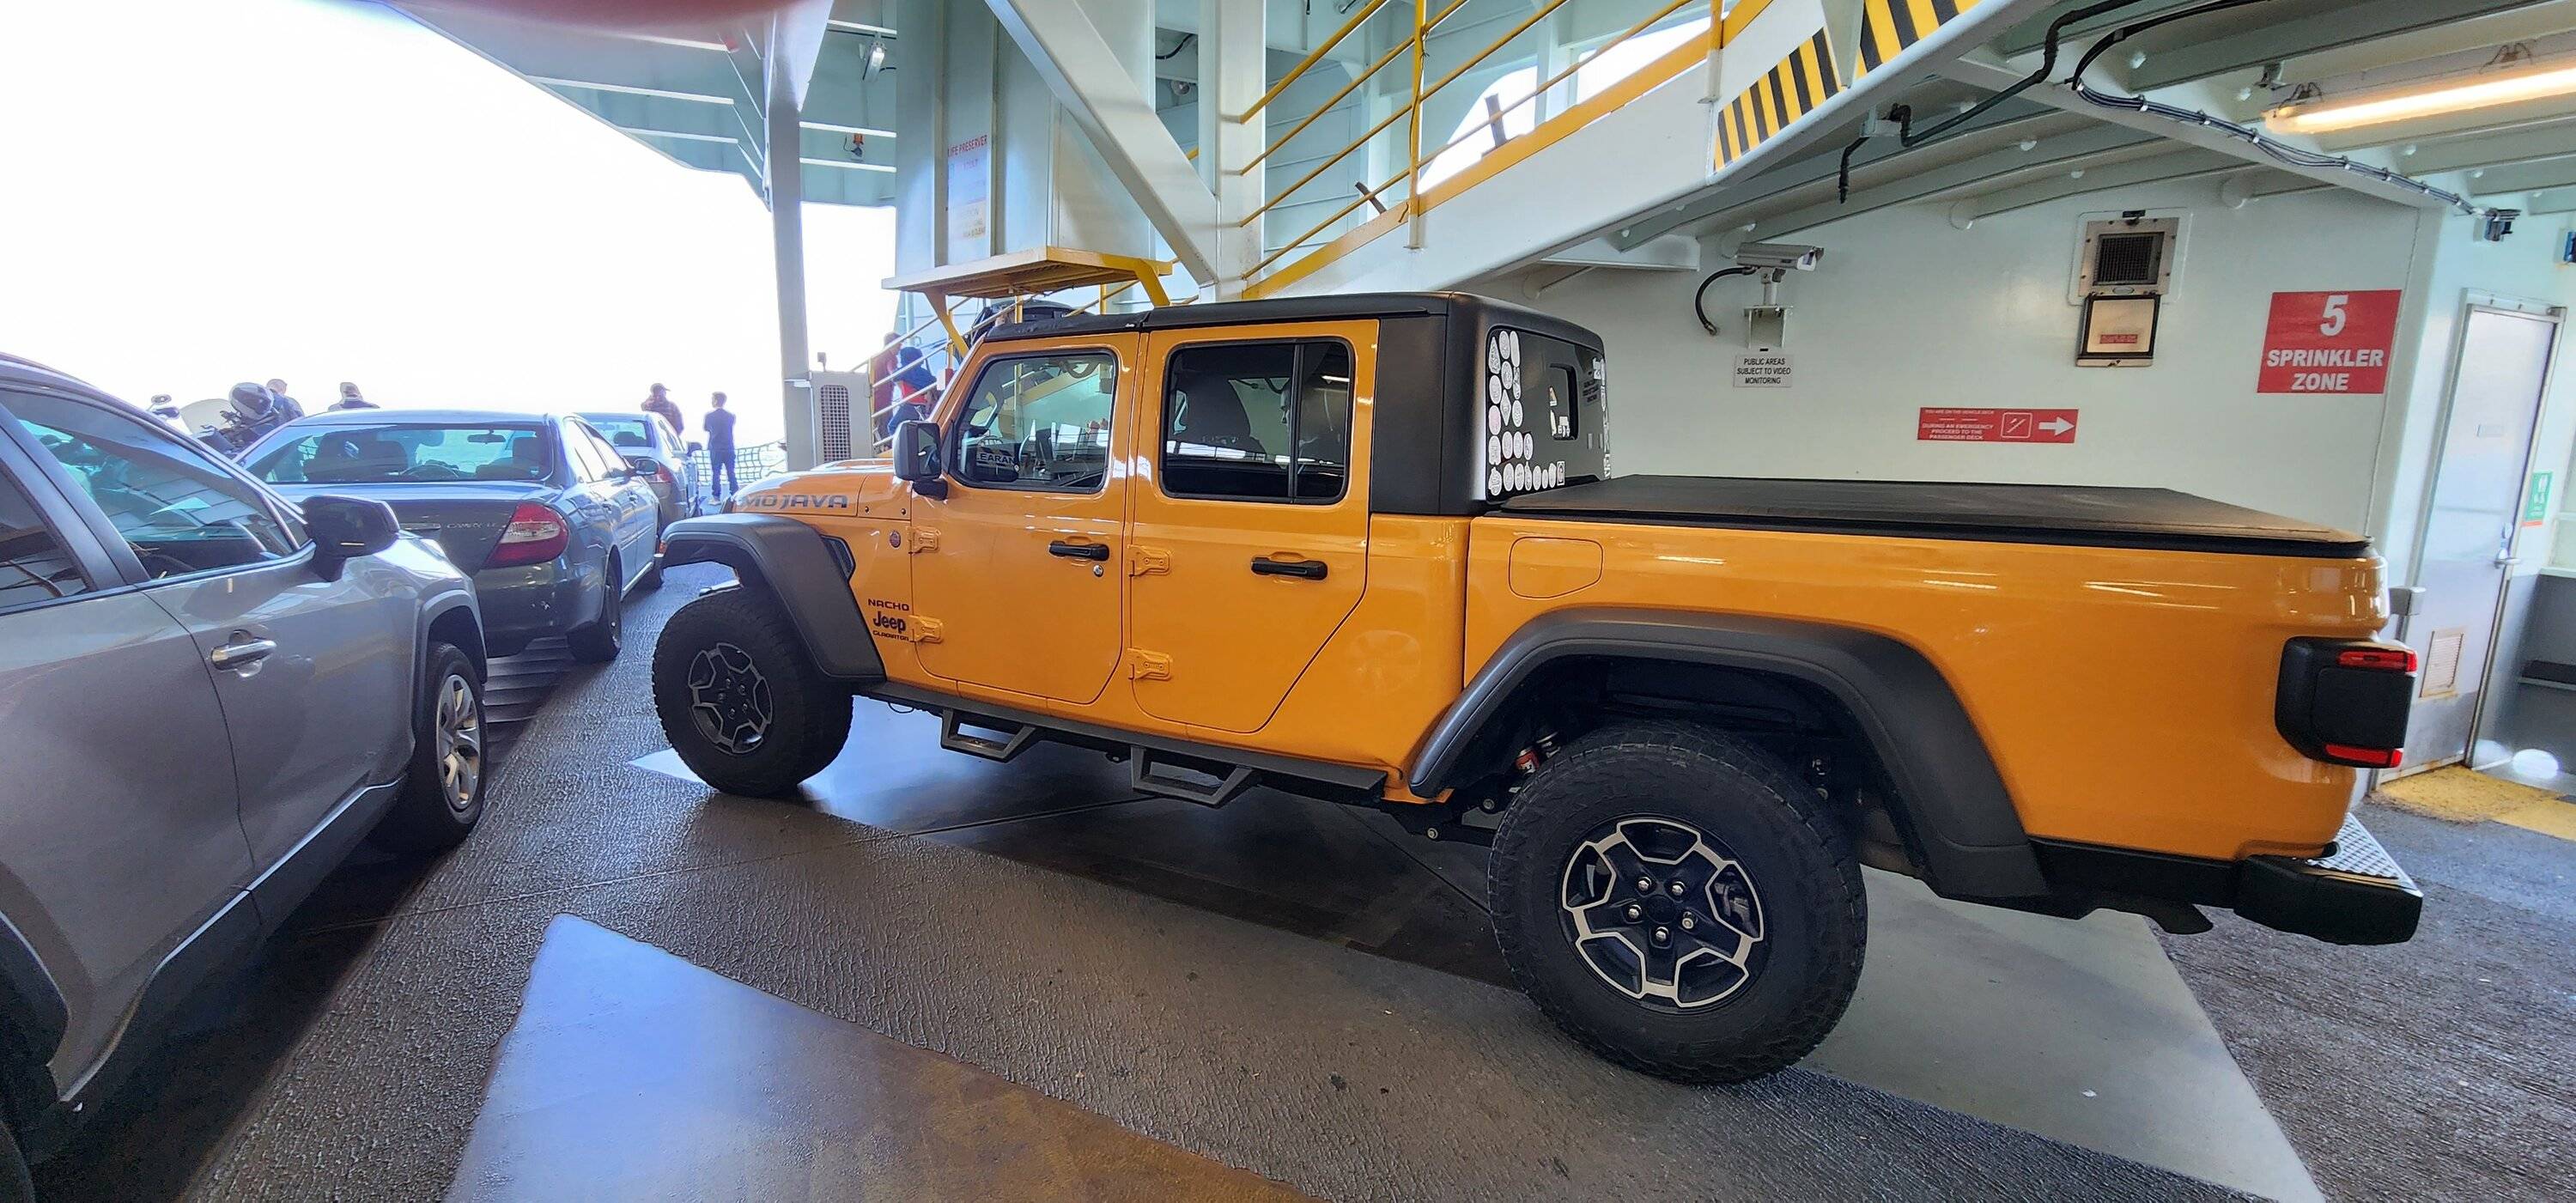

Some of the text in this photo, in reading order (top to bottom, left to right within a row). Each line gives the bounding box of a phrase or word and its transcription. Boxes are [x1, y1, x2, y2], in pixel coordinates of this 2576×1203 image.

[959, 134, 987, 154] PRESERVER
[2319, 295, 2349, 337] 5
[1743, 357, 1786, 366] PUBLIC AREAS
[2266, 349, 2385, 368] SPRINKLER
[1736, 367, 1791, 375] SUBJECT TO VIDEO
[2291, 373, 2350, 391] ZONE
[867, 598, 910, 611] NACHO
[872, 611, 907, 634] Jeep
[872, 629, 910, 642] GLADIATOR
